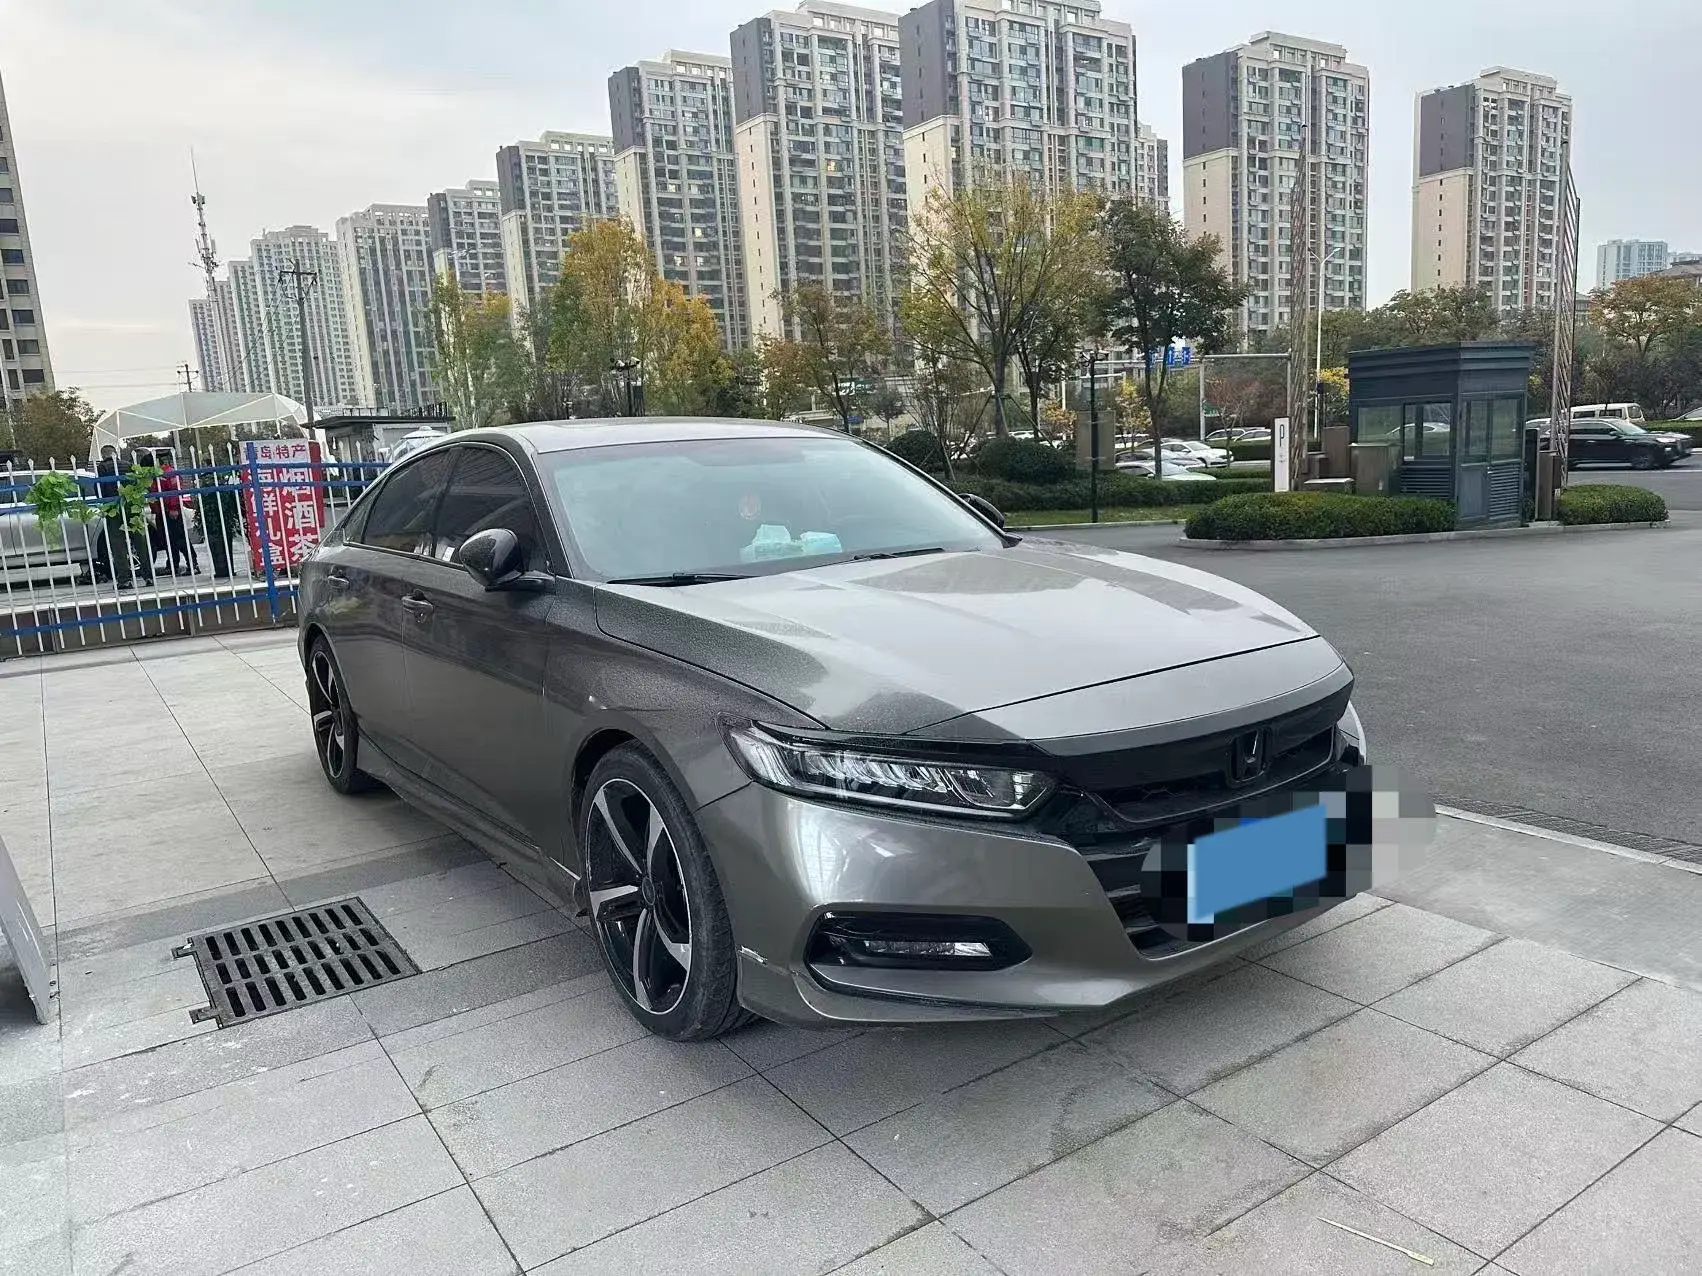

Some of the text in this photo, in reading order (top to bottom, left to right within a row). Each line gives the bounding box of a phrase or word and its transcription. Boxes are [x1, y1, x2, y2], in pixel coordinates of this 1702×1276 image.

[1279, 424, 1285, 447] P
[279, 466, 317, 561] 烟酒茶
